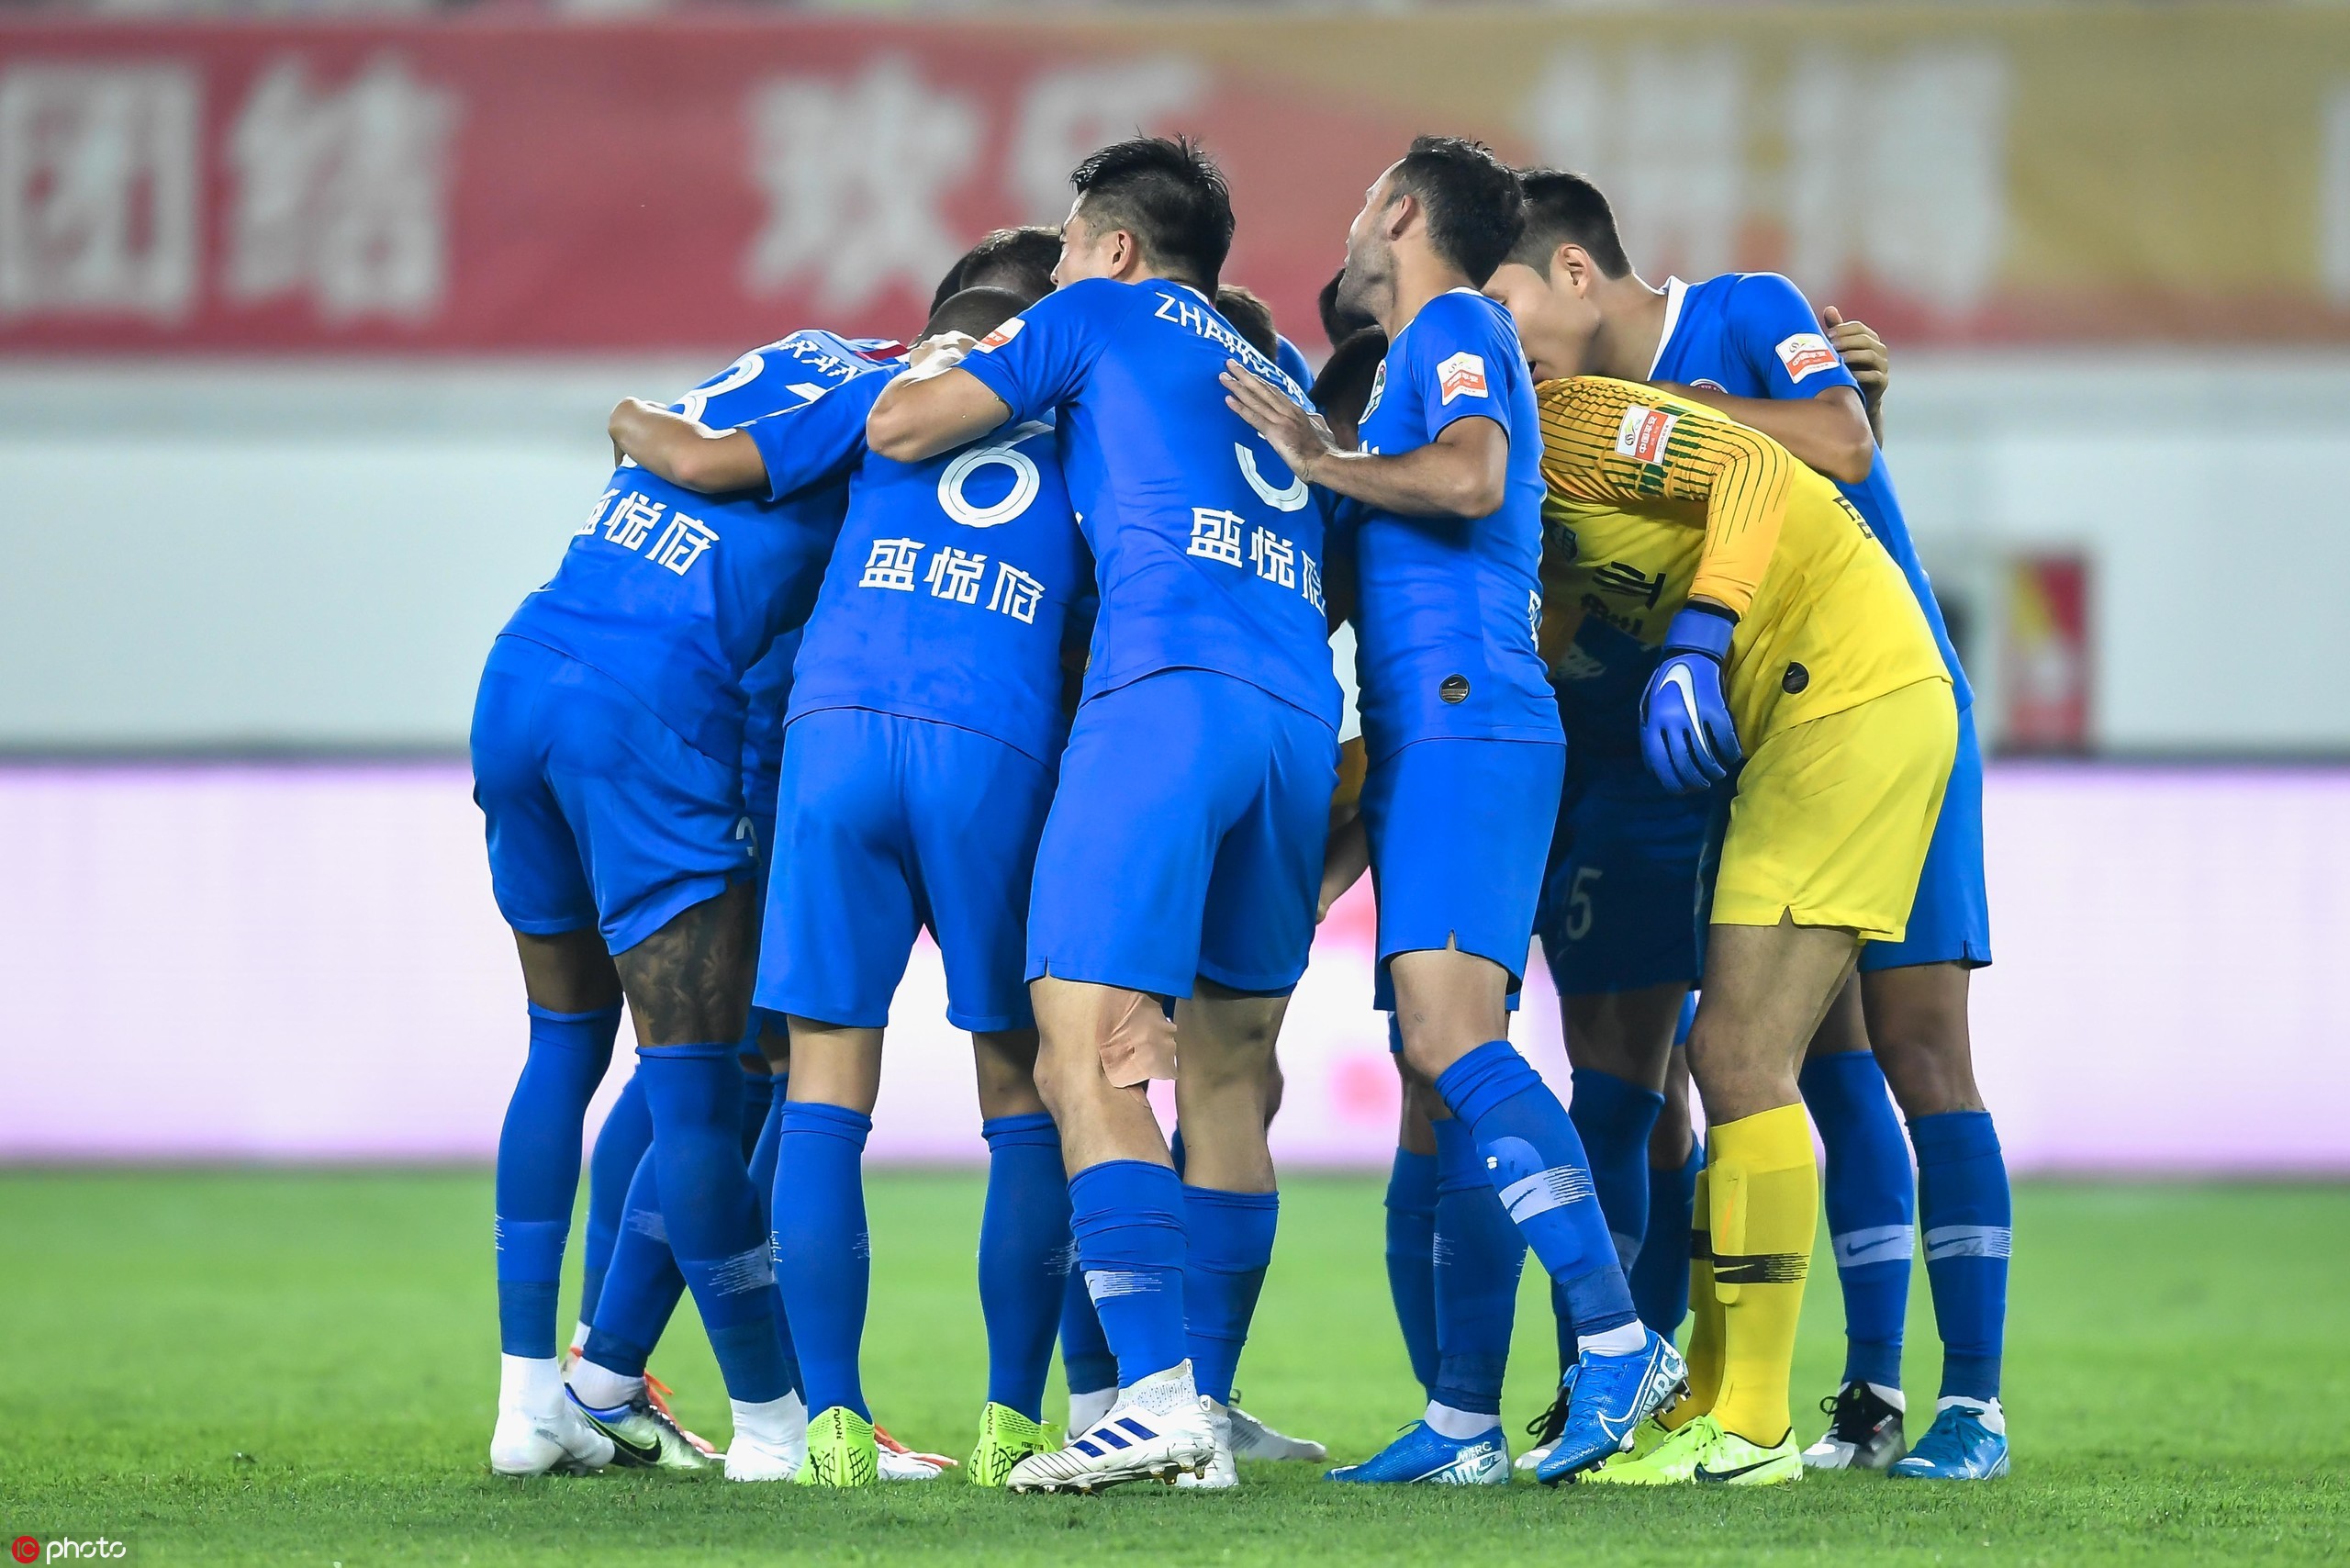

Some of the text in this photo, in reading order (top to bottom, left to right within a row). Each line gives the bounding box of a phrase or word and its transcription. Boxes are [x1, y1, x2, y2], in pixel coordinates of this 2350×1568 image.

[0, 50, 452, 317] 团结
[858, 537, 1046, 625] 盛悦府
[1186, 507, 1326, 617] 盛悦府
